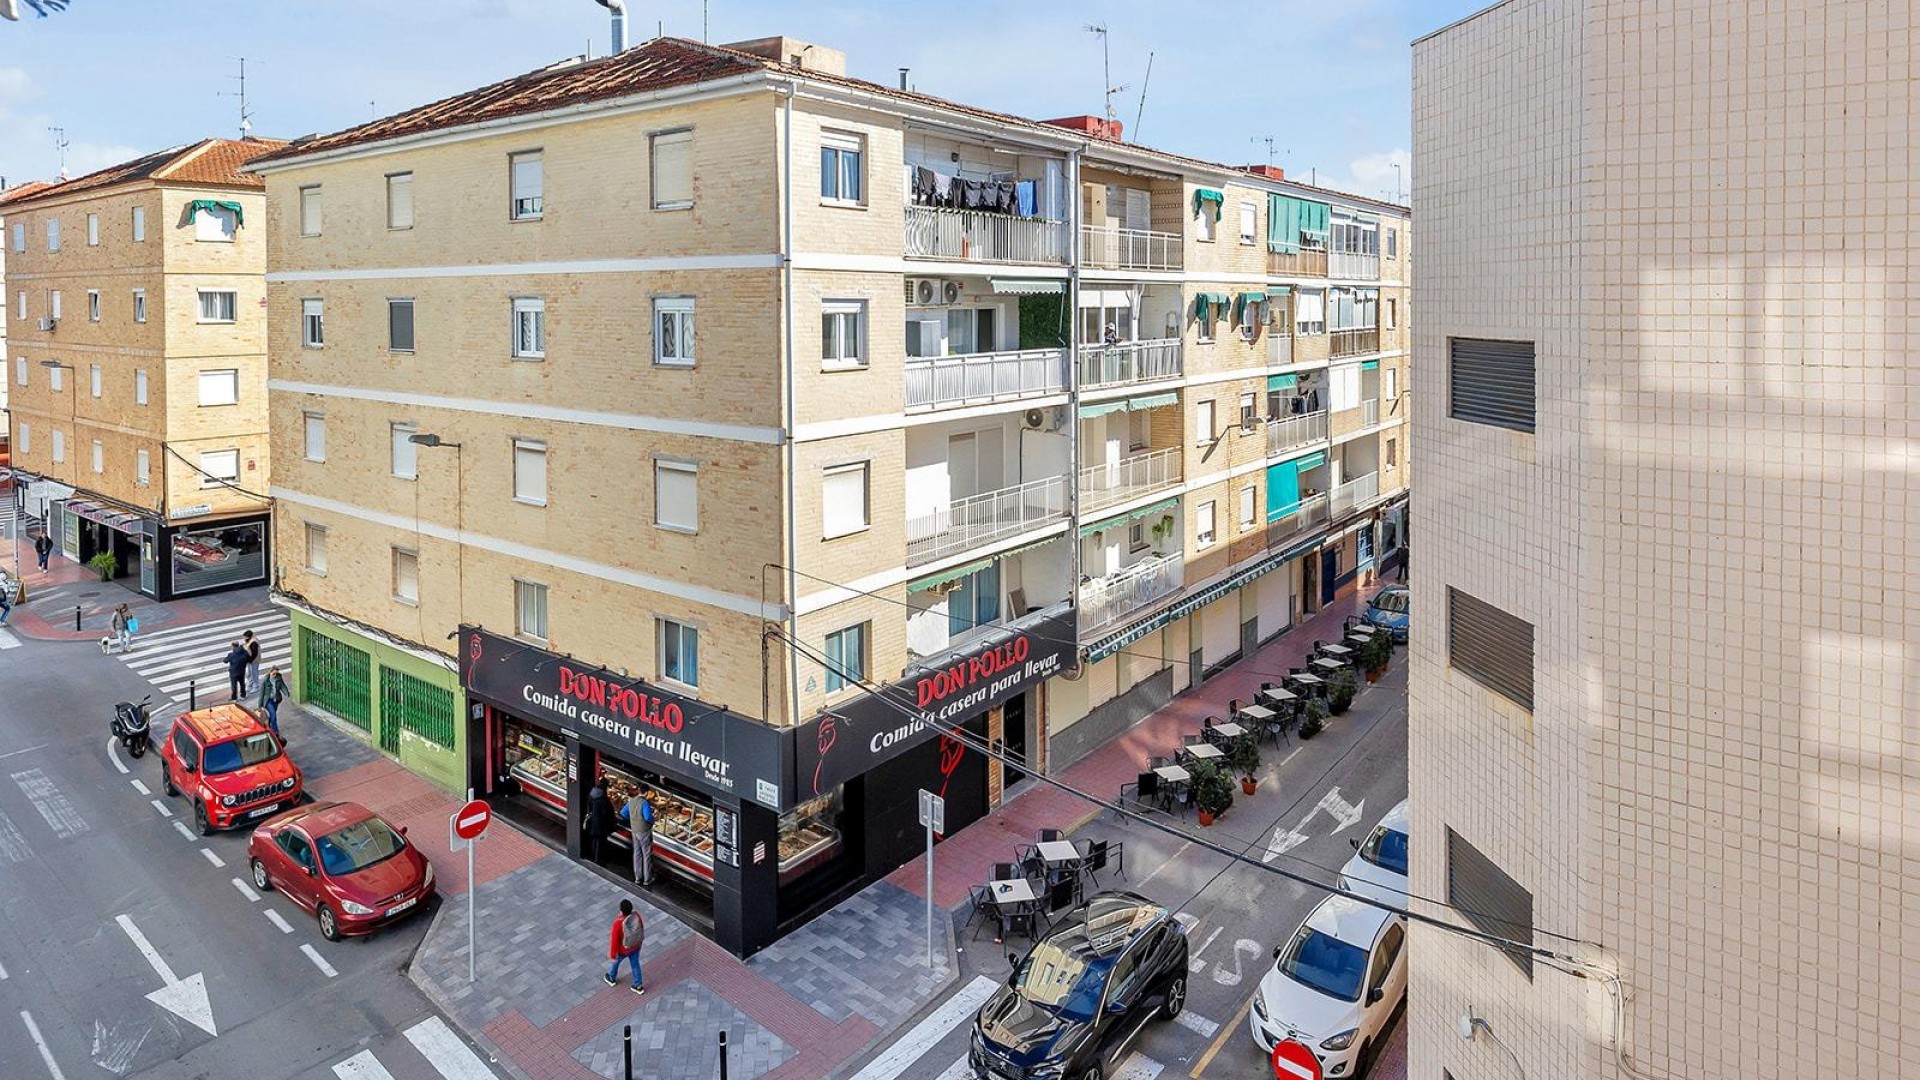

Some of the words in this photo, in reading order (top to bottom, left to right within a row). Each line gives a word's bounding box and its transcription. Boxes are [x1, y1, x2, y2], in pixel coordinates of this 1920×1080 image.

[917, 665, 965, 707] DON
[968, 635, 1029, 684] POLLO
[1103, 620, 1160, 657] COMIDAS
[523, 685, 577, 719] Comida
[581, 710, 630, 739] casera
[635, 731, 674, 756] para
[679, 742, 730, 776] llevar
[559, 667, 605, 707] DON
[606, 681, 684, 734] POLLO
[870, 710, 937, 754] Comida
[939, 690, 986, 720] casera
[990, 673, 1021, 700] para
[1025, 653, 1059, 678] llevar
